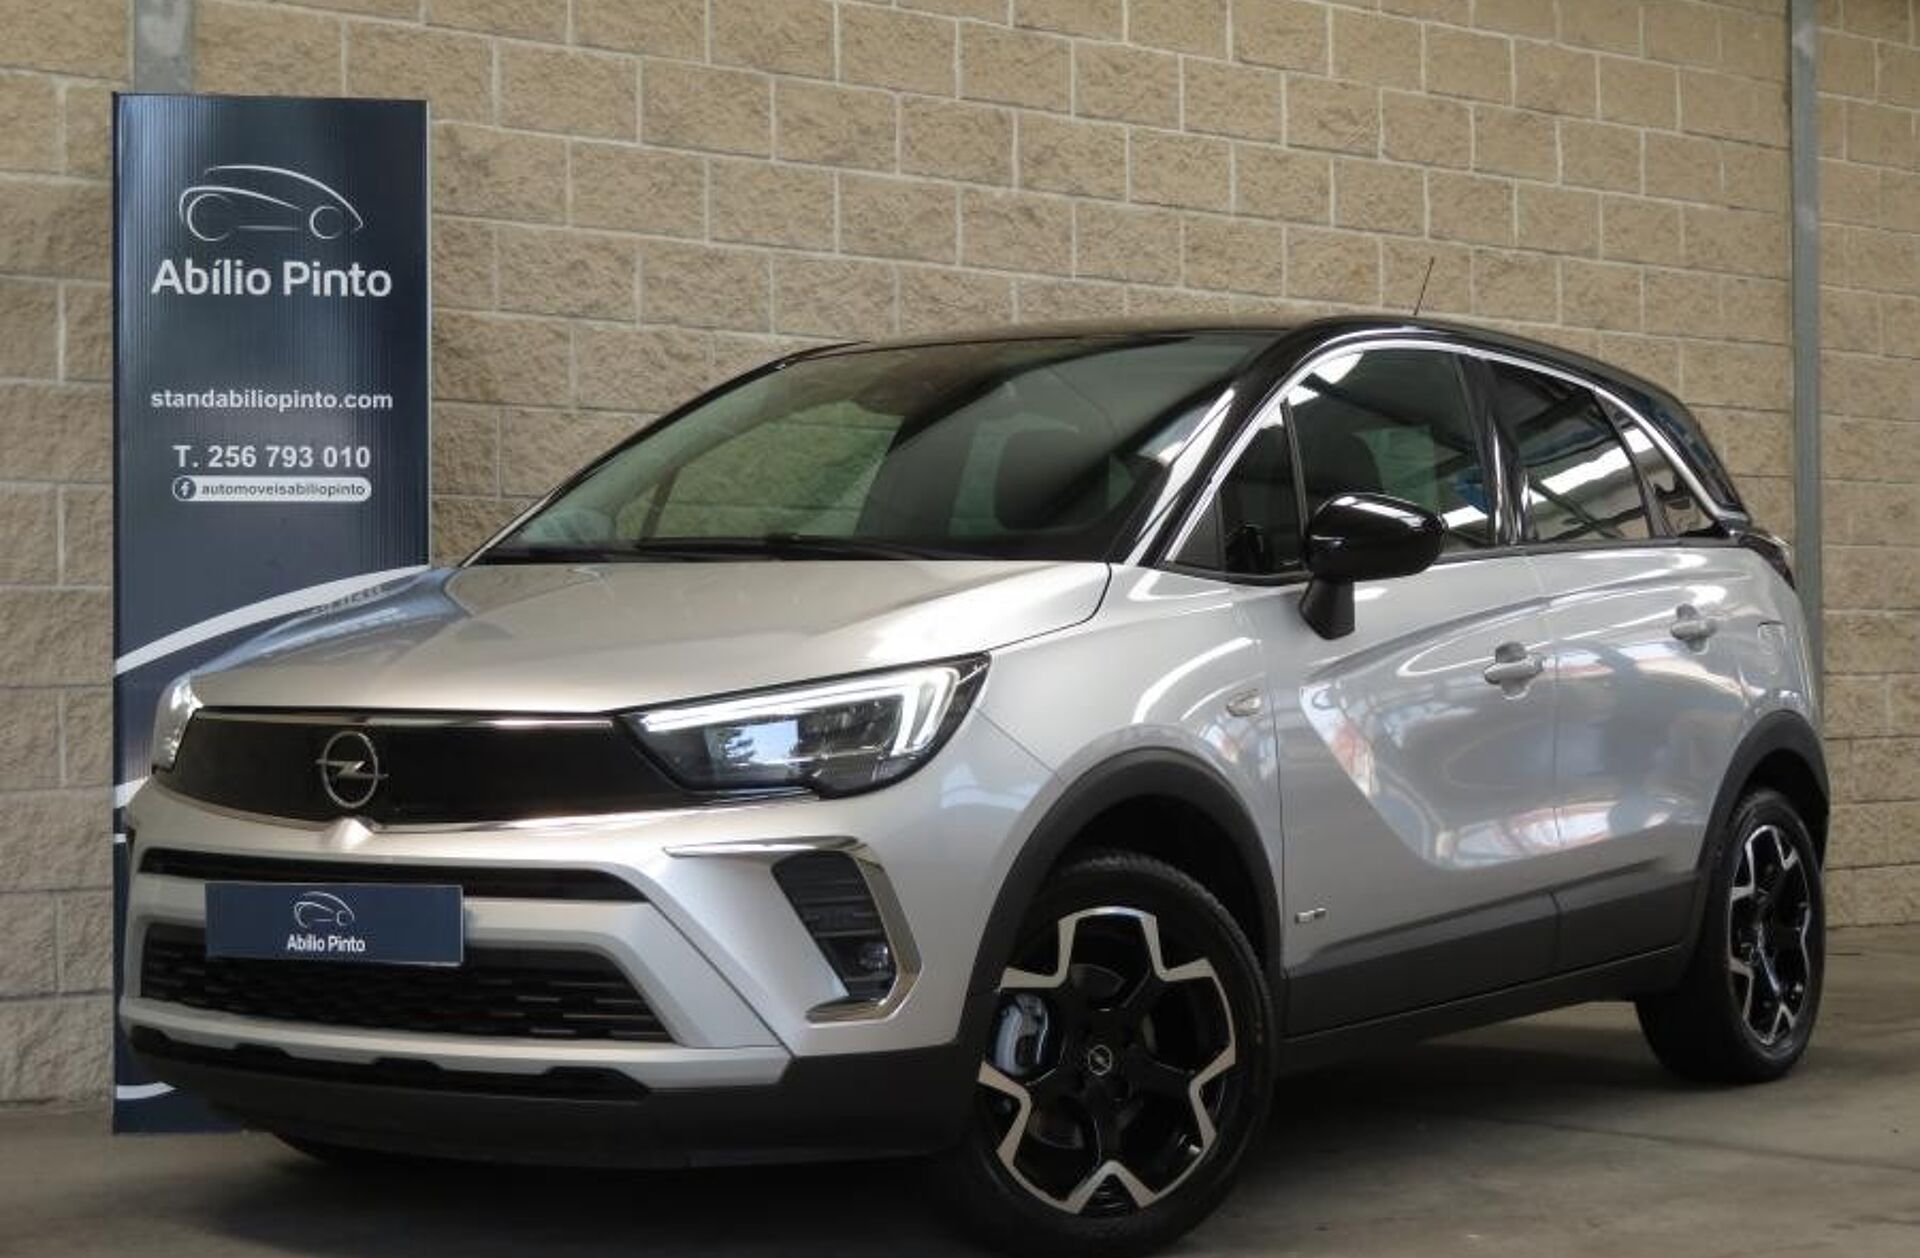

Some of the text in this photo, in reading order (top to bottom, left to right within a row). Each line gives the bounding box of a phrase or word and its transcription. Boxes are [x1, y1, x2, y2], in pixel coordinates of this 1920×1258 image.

[151, 258, 393, 297] Abílio Pinto
[151, 389, 394, 412] standabiliopinto.com
[172, 445, 371, 468] T. 256 793 010
[201, 482, 366, 498] automoveisabiliopinto
[328, 935, 366, 953] Pinto
